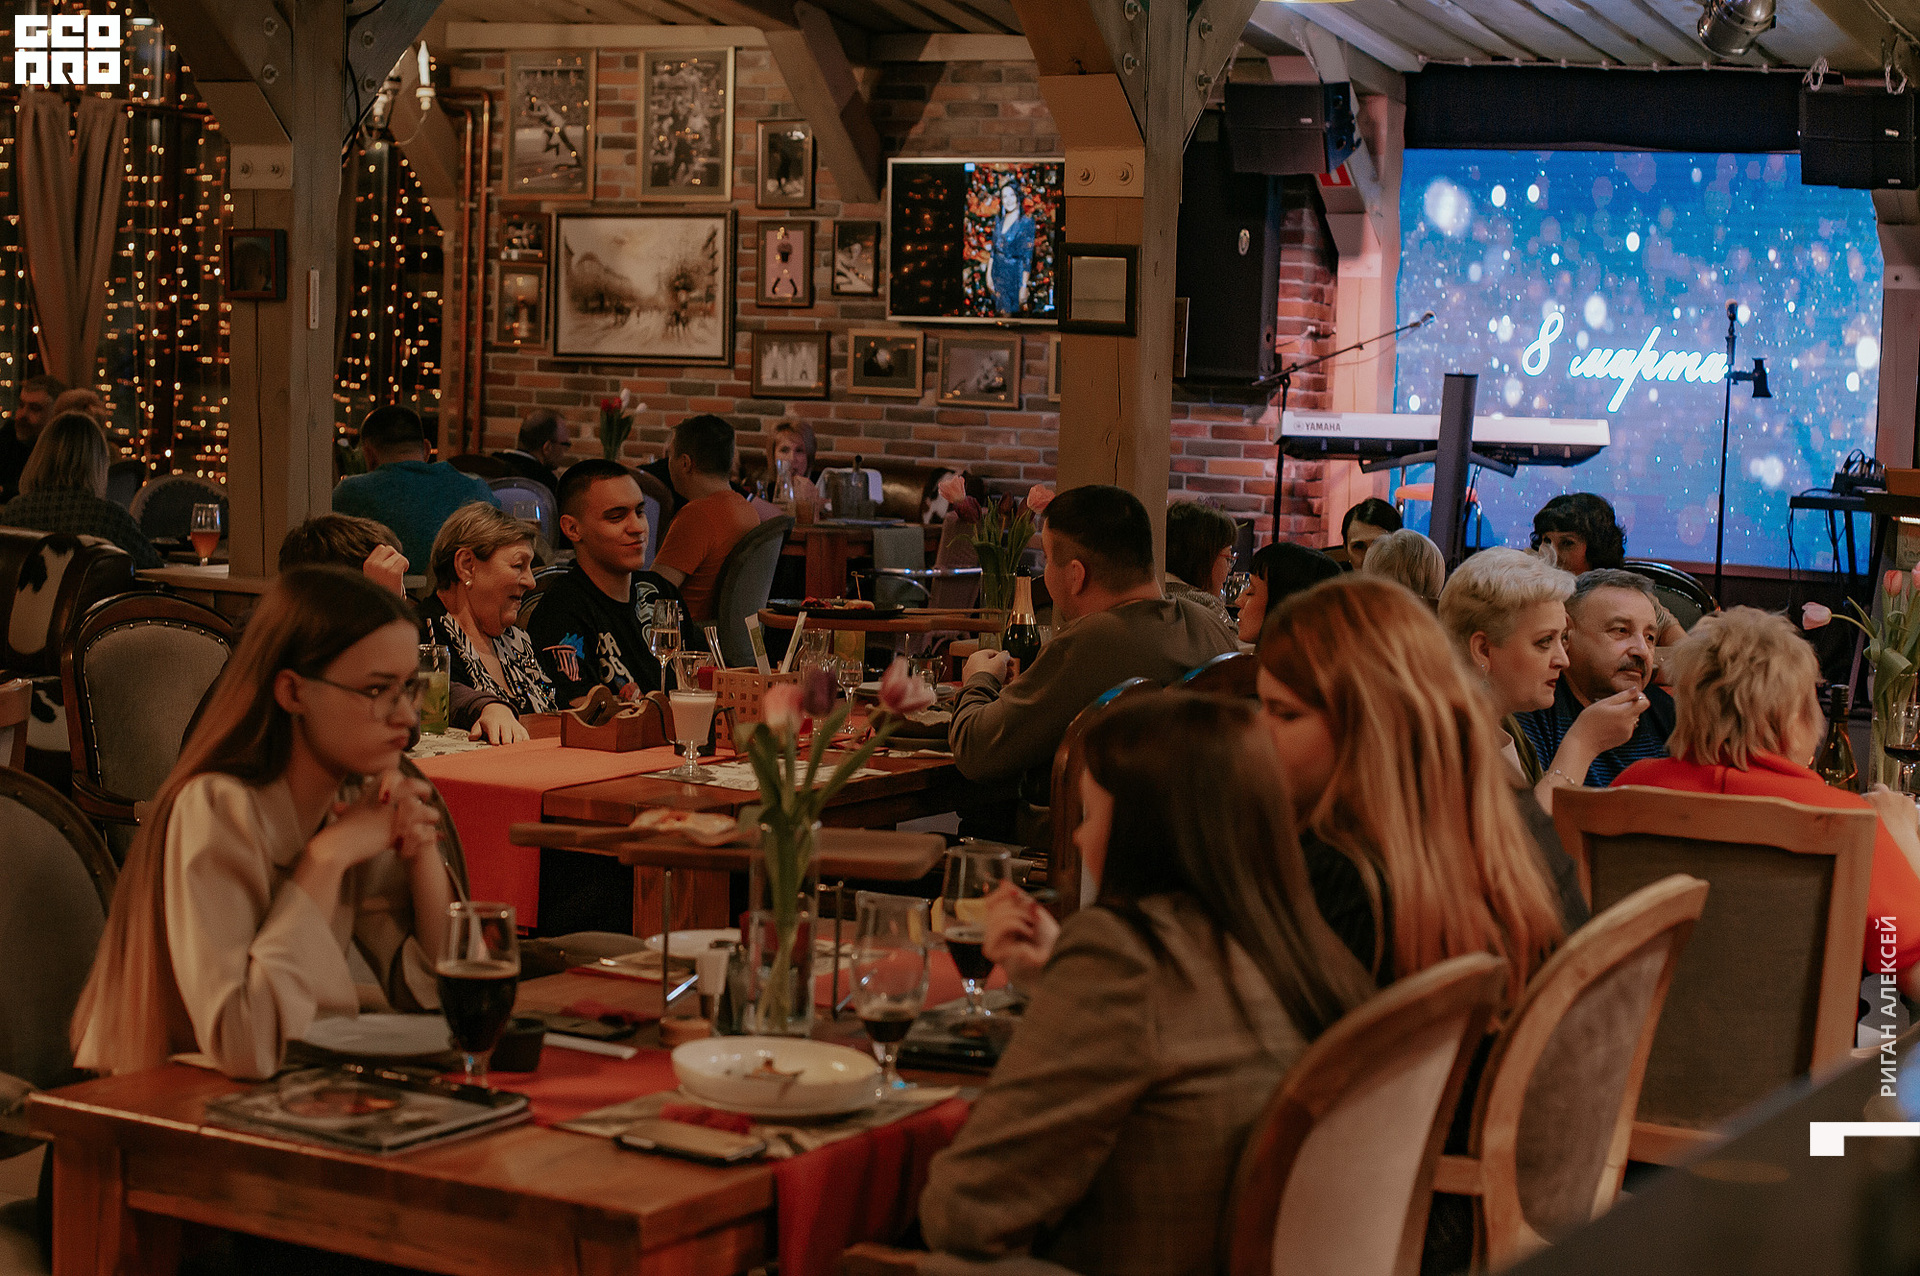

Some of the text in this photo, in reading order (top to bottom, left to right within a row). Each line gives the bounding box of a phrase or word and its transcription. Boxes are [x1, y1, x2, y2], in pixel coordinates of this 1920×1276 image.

[1522, 311, 1729, 413] 8 марта
[1304, 422, 1341, 432] YAMAHA
